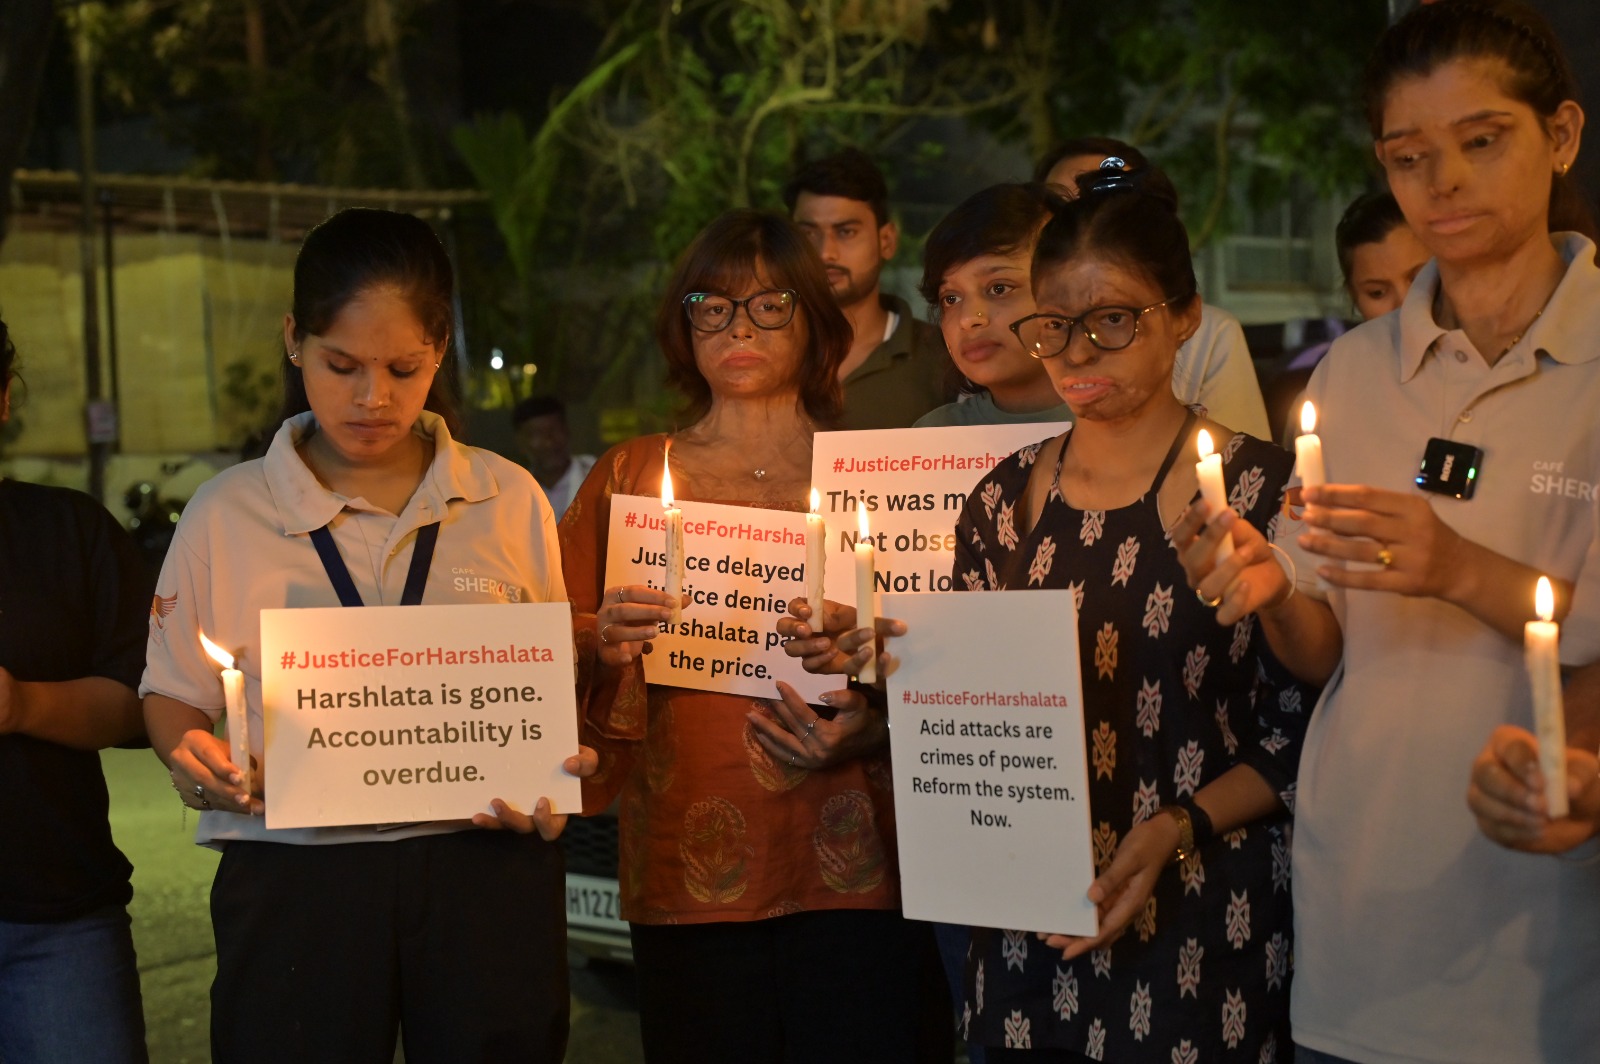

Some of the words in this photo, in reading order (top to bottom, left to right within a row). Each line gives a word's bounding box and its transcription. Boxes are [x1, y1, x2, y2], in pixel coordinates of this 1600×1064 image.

[833, 452, 1013, 473] #JusticeForHarsh
[826, 489, 879, 513] This
[886, 493, 935, 511] was
[625, 512, 806, 546] #JusceForHarsha
[894, 529, 957, 552] obse
[631, 547, 710, 572] Jusce
[716, 555, 805, 583] delayed
[453, 577, 521, 603] SHEROES
[873, 571, 921, 593] Not
[929, 569, 953, 592] lo
[725, 590, 787, 614] denie
[658, 618, 759, 645] arshalata
[280, 644, 554, 669] #JusticeForHarshalata
[669, 650, 705, 672] the
[711, 657, 772, 680] price.
[297, 685, 433, 710] Harshlata
[440, 683, 462, 705] is
[470, 685, 543, 710] gone.
[902, 690, 1068, 708] #JusticeForHarshalata
[307, 721, 513, 749] Accountability
[521, 719, 542, 741] is
[920, 719, 955, 736] Acid
[960, 721, 1021, 738] attacks
[1025, 725, 1053, 739] are
[920, 748, 974, 766] crimes
[979, 750, 996, 767] of
[1000, 755, 1058, 772] power.
[362, 761, 486, 786] overdue.
[912, 777, 971, 796] Reform
[975, 780, 1004, 797] the
[1008, 784, 1076, 803] system.
[971, 810, 1012, 828] Now.
[567, 886, 620, 919] H12Z
